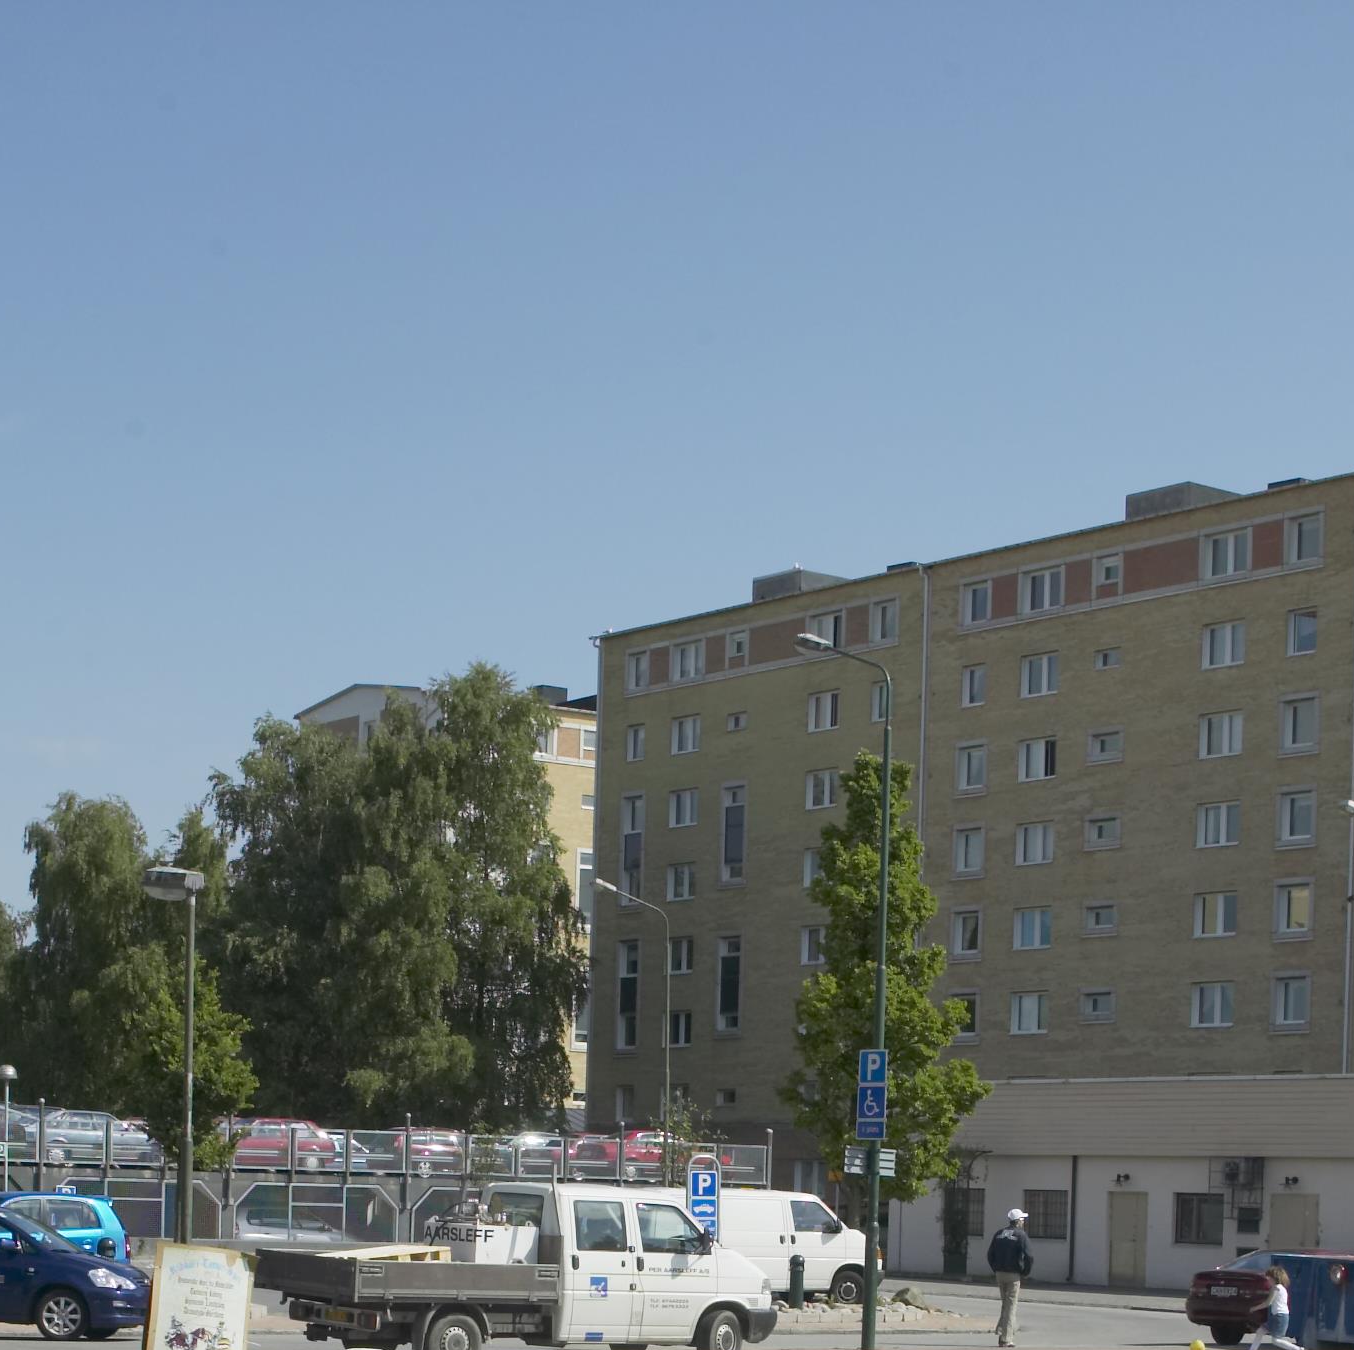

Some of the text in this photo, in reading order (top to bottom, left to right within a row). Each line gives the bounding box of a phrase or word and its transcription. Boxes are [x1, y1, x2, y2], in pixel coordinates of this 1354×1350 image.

[867, 1053, 880, 1080] P
[698, 1173, 712, 1196] P
[425, 1225, 494, 1243] AARSLEFF
